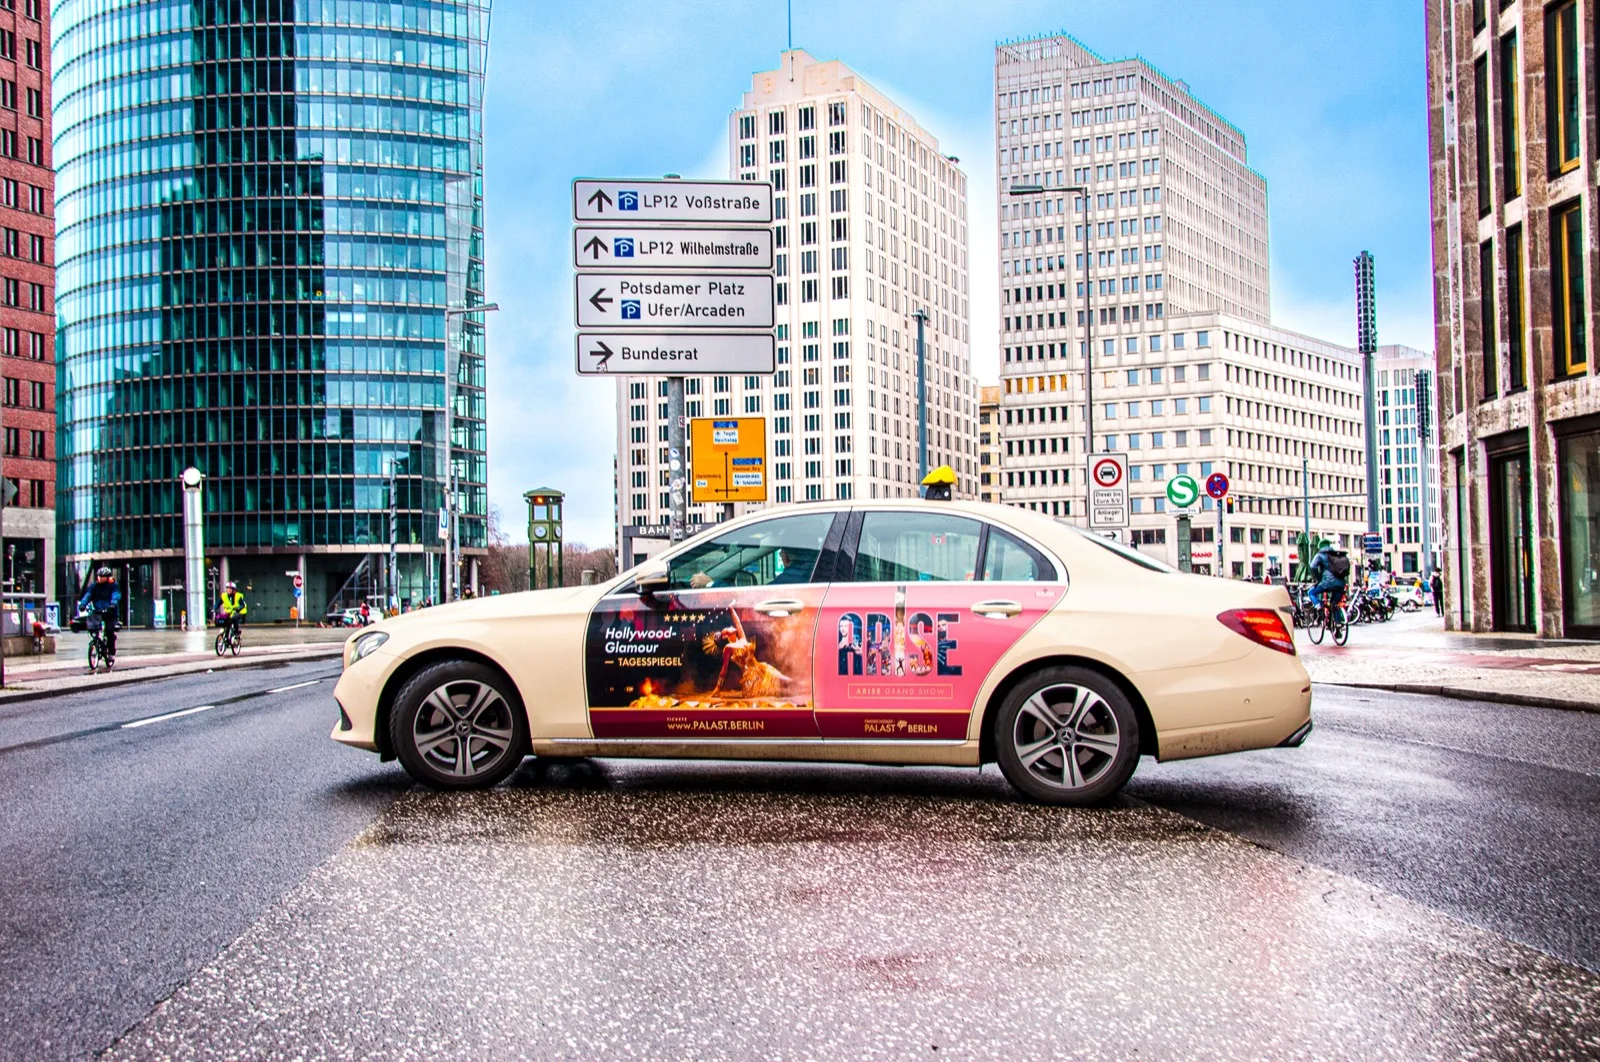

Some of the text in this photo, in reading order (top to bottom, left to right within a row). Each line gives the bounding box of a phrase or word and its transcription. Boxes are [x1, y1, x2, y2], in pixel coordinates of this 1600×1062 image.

[643, 195, 678, 208] LP12
[685, 195, 760, 210] Voßstraße
[639, 242, 674, 255] LP12
[680, 242, 759, 256] Wilhelmstraße
[620, 281, 745, 296] Potsdamer Platz
[648, 304, 745, 317] Ufer/Arcaden
[621, 347, 698, 361] Bundesrat
[1171, 477, 1194, 504] S
[639, 524, 702, 535] BAHOF
[604, 626, 677, 643] Hollywood-
[837, 585, 963, 677] ARISE
[604, 641, 659, 654] Glamour
[617, 657, 683, 667] TAGESSPIEGEL
[855, 687, 945, 695] ARISE GRAND SHOW
[667, 720, 765, 731] www.PALAST.BERLIN
[864, 723, 938, 733] PALAST BERLIN
